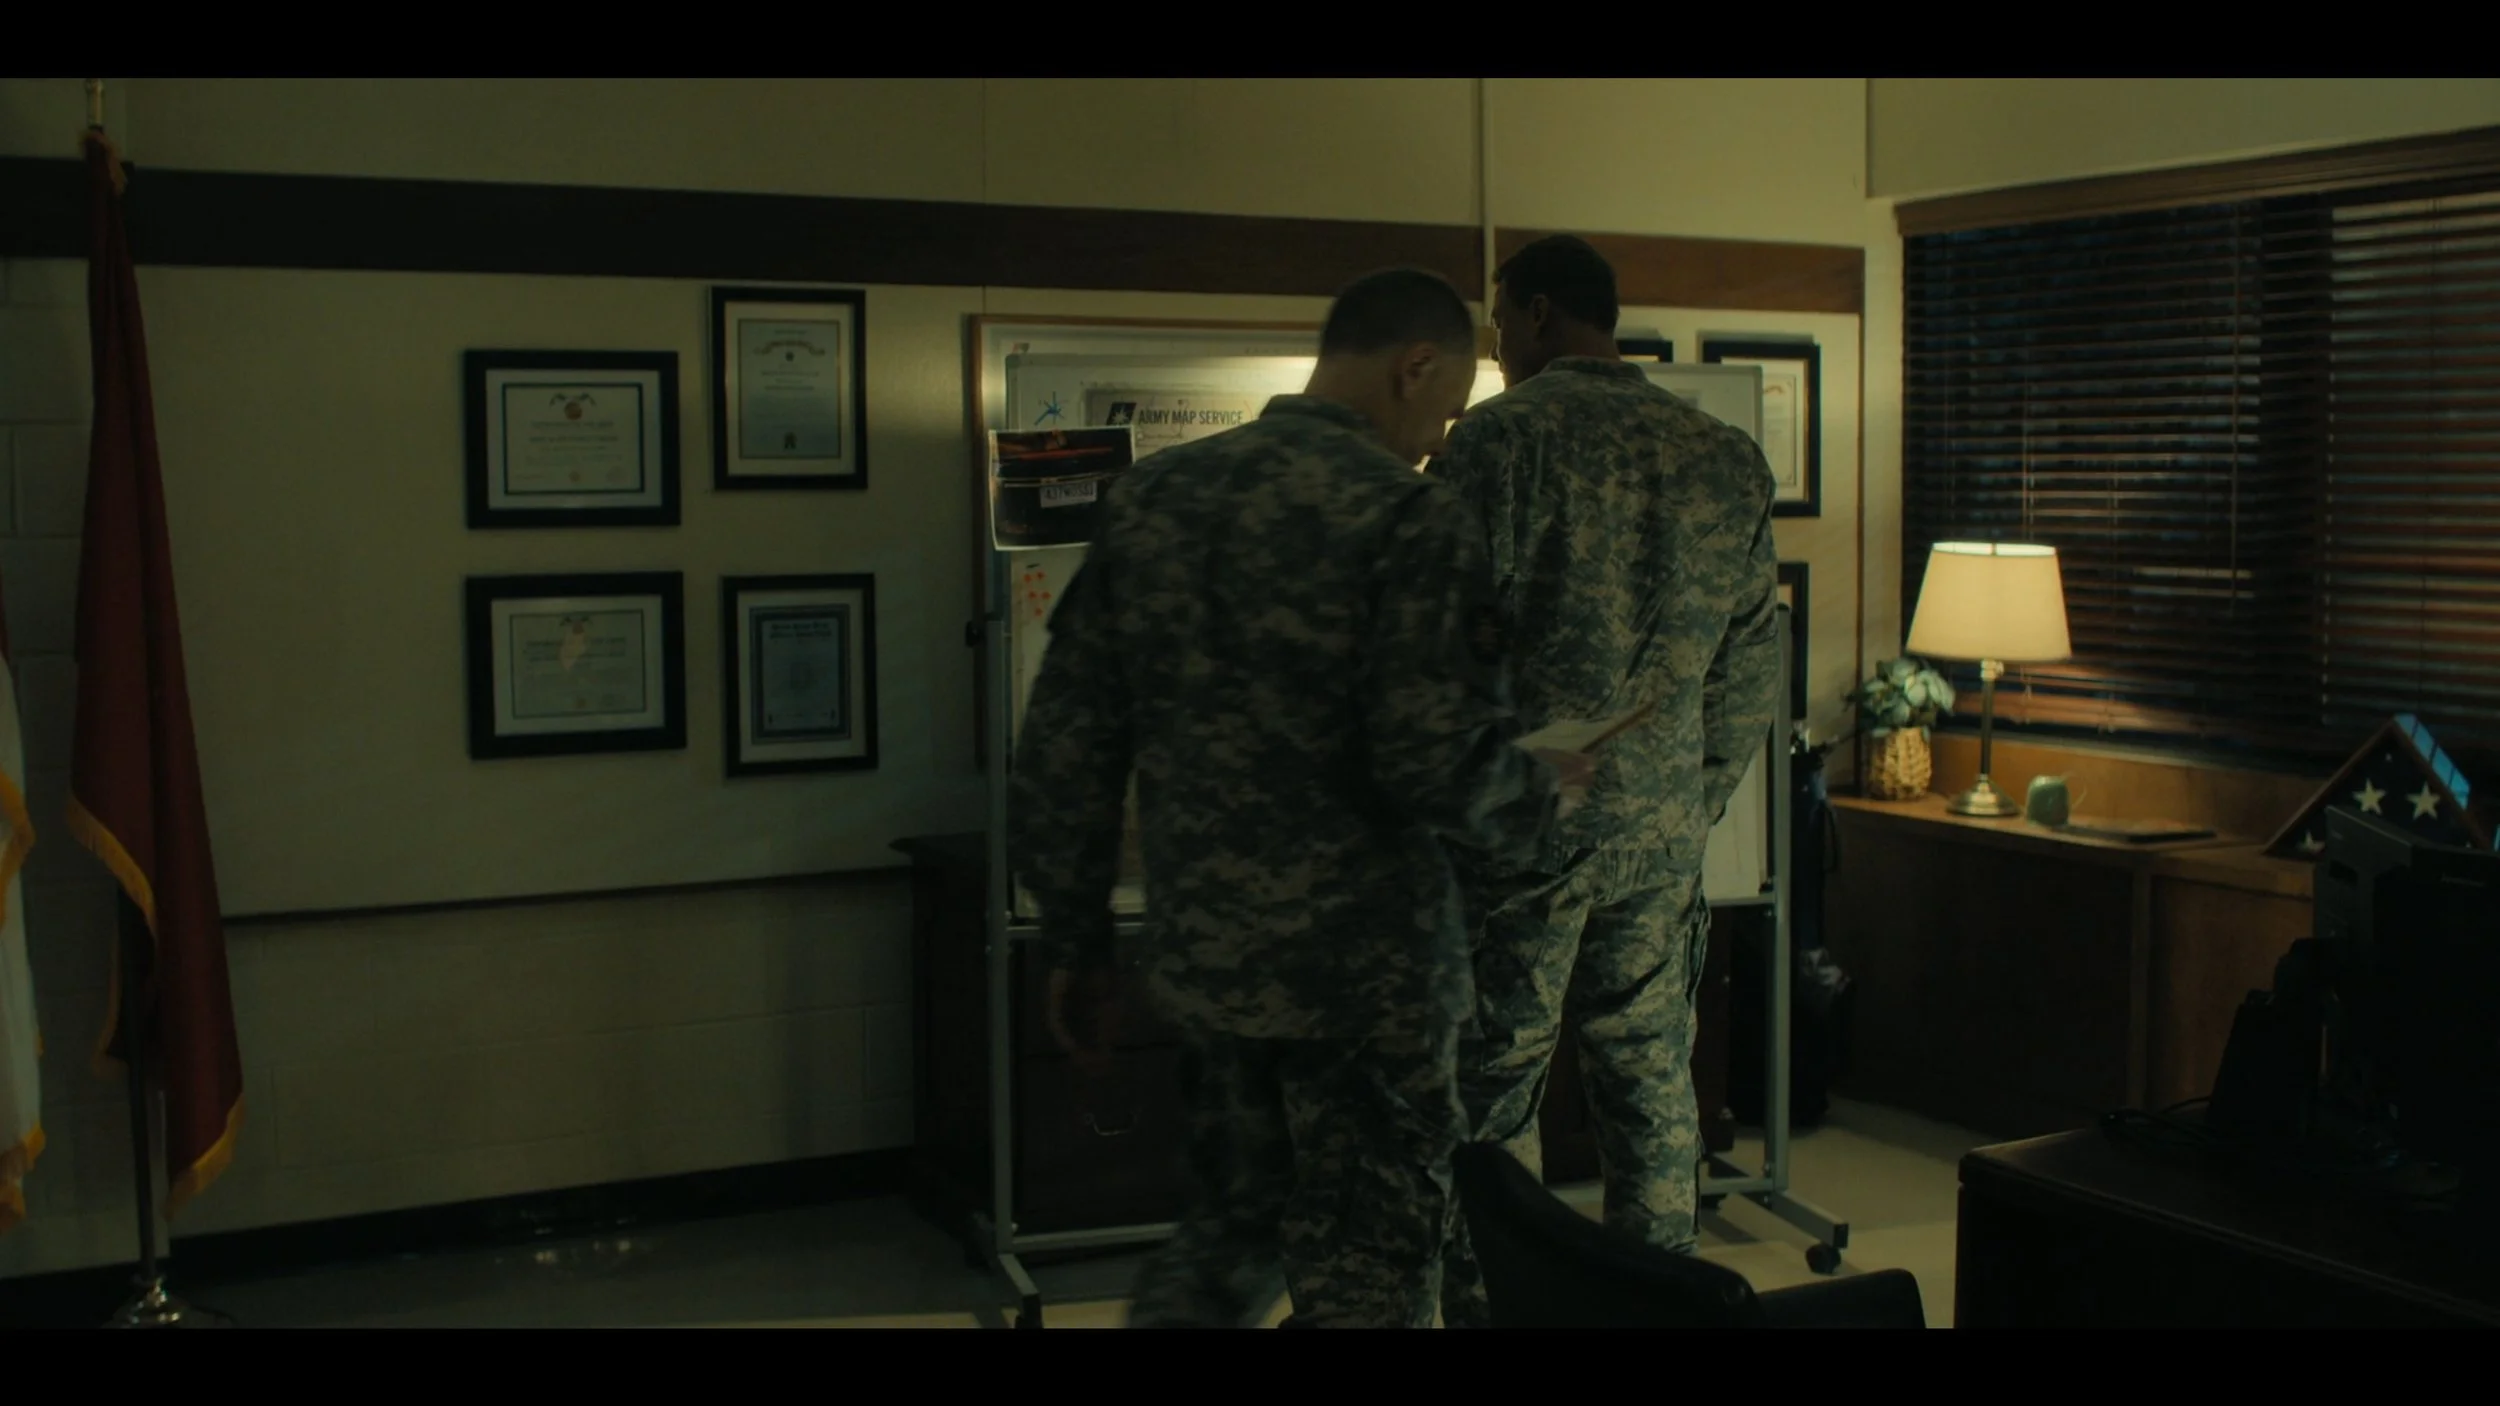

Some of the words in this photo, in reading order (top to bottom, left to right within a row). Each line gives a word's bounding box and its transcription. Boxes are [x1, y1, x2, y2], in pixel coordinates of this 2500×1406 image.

[1138, 408, 1170, 425] ARMY
[1171, 408, 1197, 425] MAP
[1198, 408, 1243, 425] SERVICE
